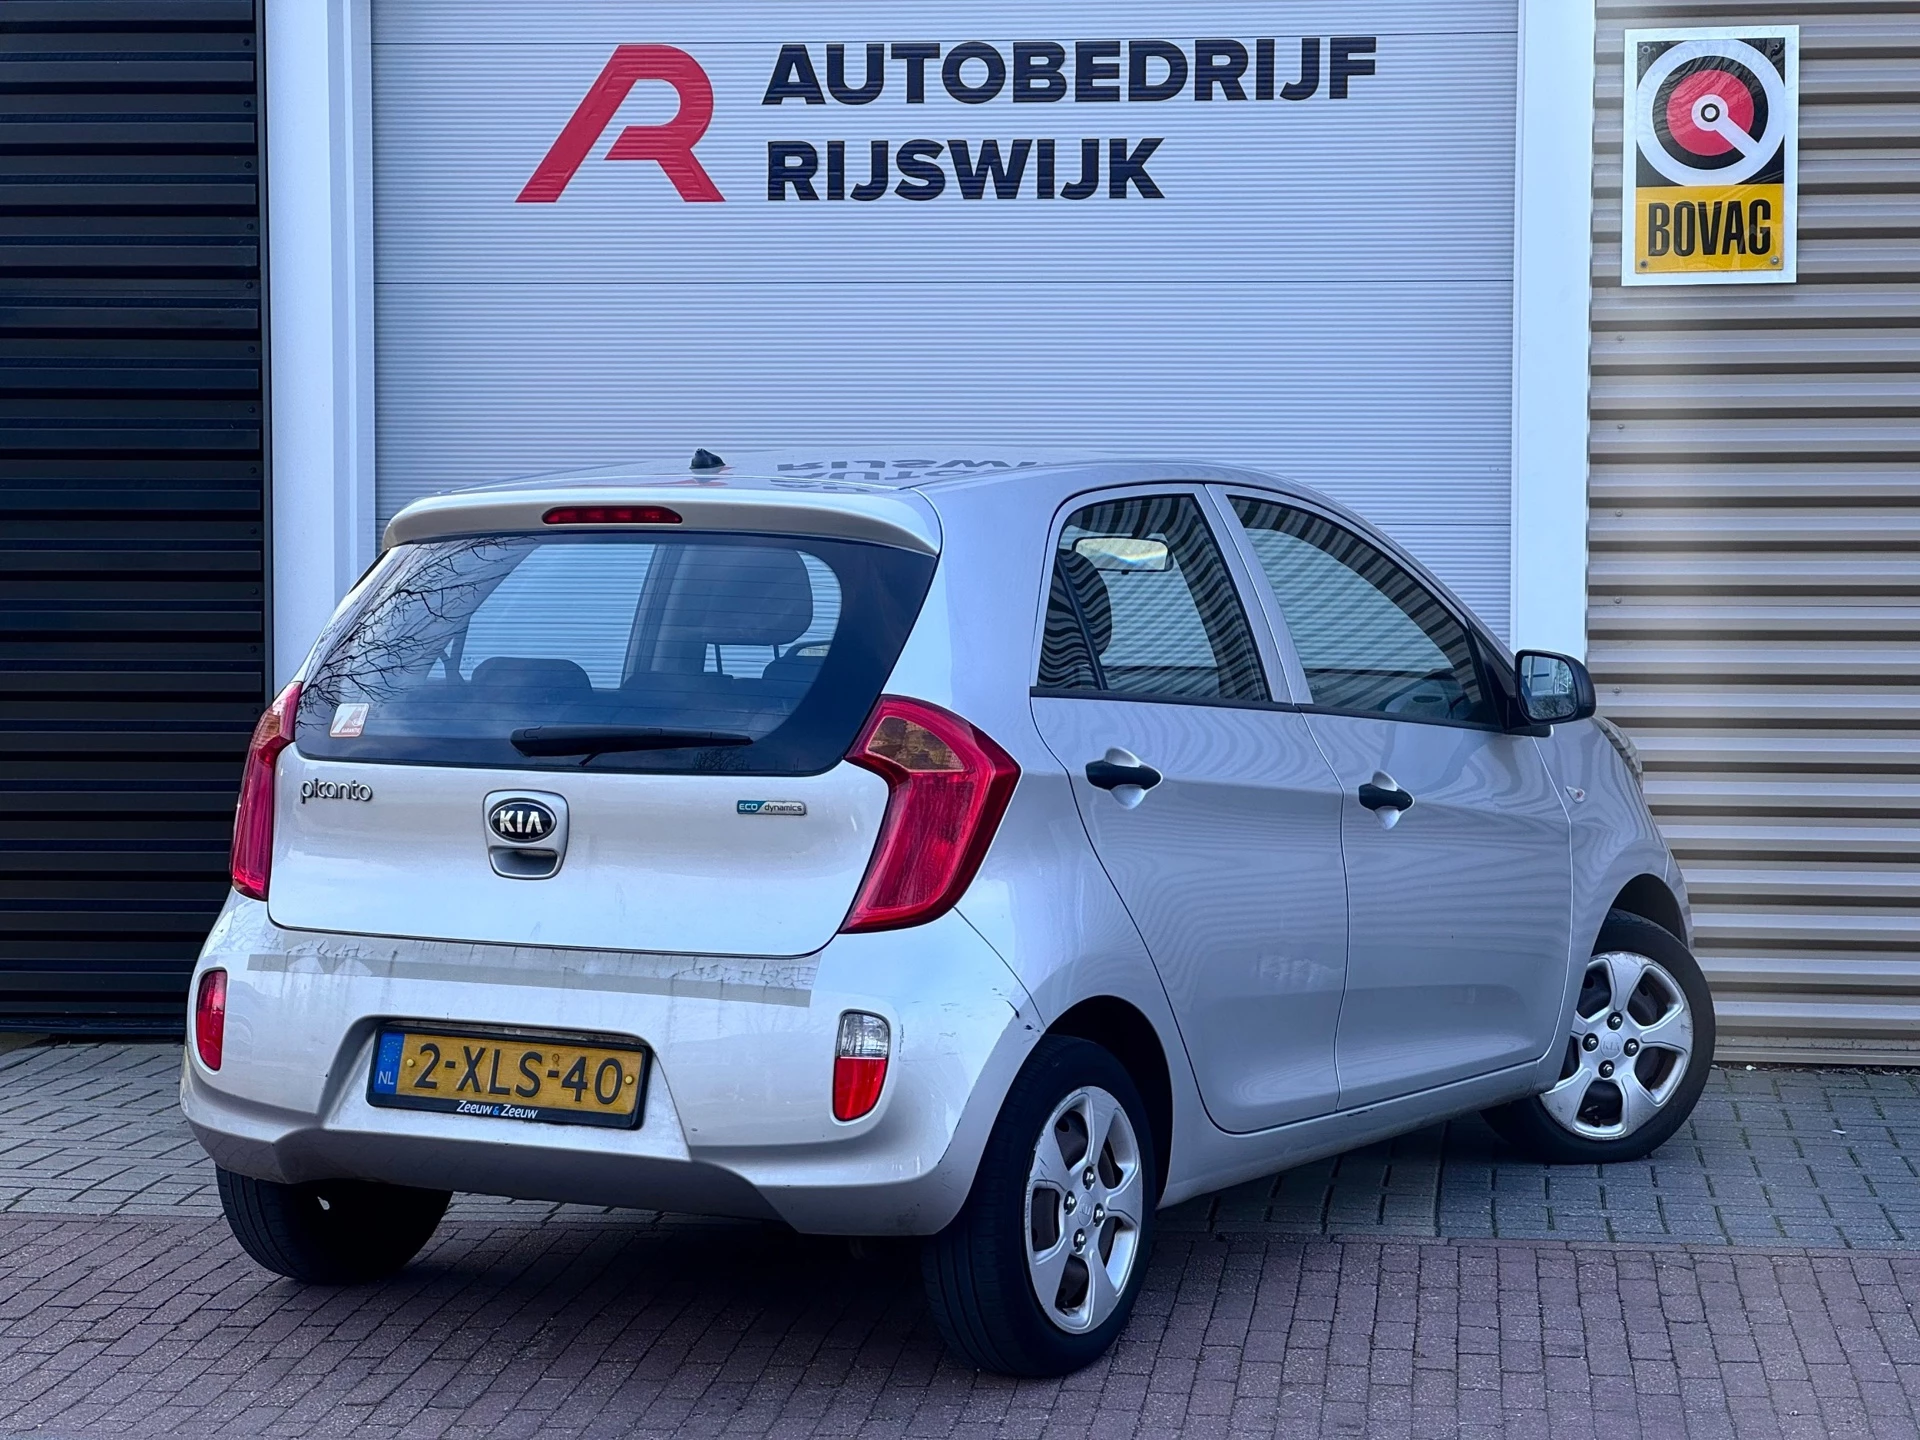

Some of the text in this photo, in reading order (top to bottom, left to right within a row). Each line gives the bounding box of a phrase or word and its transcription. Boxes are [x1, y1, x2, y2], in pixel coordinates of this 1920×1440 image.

[761, 36, 1377, 105] AUTOBEDRIJF
[767, 138, 1165, 200] RIJSWIJK
[1647, 199, 1771, 257] BOVAG
[301, 778, 373, 804] picanto
[739, 803, 802, 812] ECO dynamics
[499, 810, 543, 833] KIA
[378, 1070, 395, 1085] NL
[414, 1043, 622, 1105] 2-XLS-40
[456, 1100, 538, 1119] Zeeuw & Zeeuw
